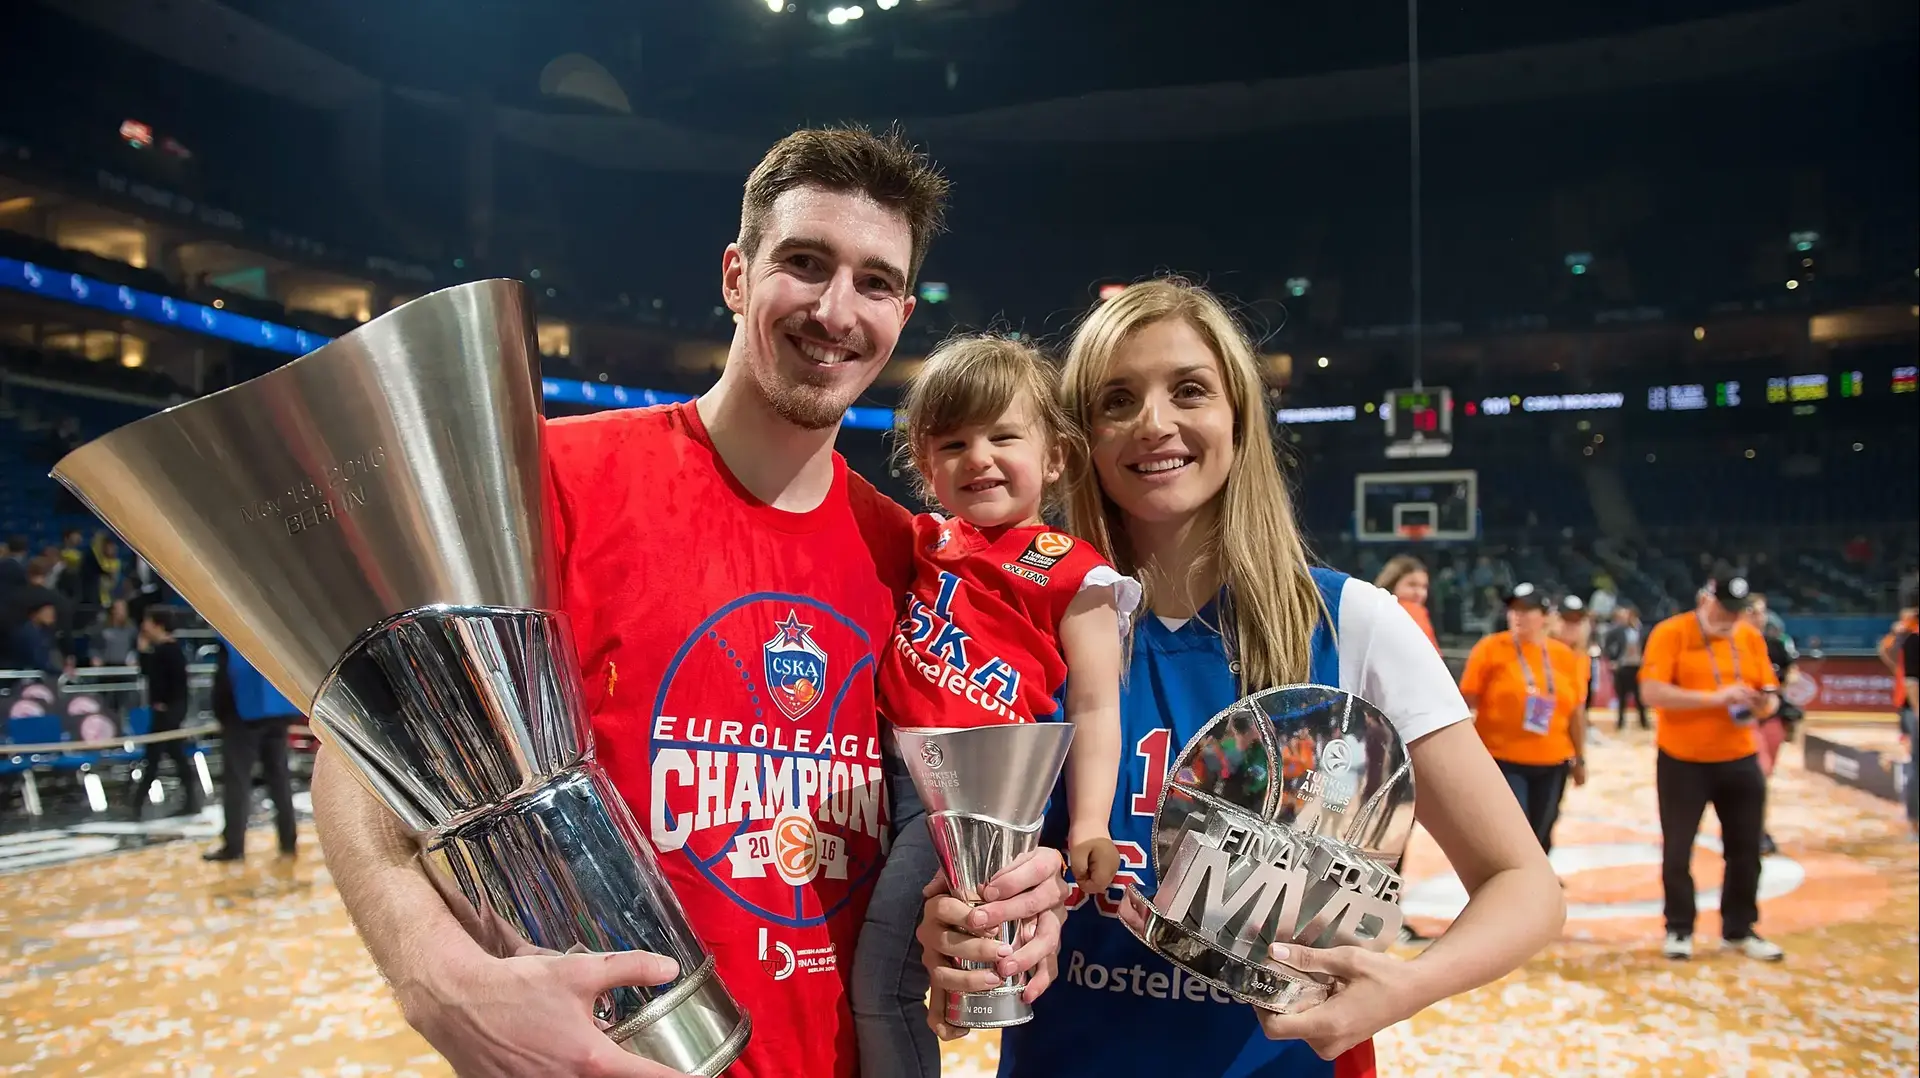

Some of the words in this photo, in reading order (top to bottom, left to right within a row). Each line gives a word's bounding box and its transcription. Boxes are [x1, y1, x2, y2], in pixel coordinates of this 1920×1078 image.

[284, 485, 366, 536] BERLIN
[1028, 550, 1056, 562] TURKISH
[900, 592, 1021, 706] SKA
[773, 657, 819, 677] CSKA
[1297, 792, 1347, 815] EUREAGUE
[1300, 780, 1351, 806] AIRLINES
[748, 836, 770, 859] 20
[821, 839, 836, 861] 16
[1220, 825, 1308, 873] FINAL
[1321, 857, 1404, 905] FOUR
[1164, 845, 1404, 958] MVP
[973, 1006, 993, 1014] 2016
